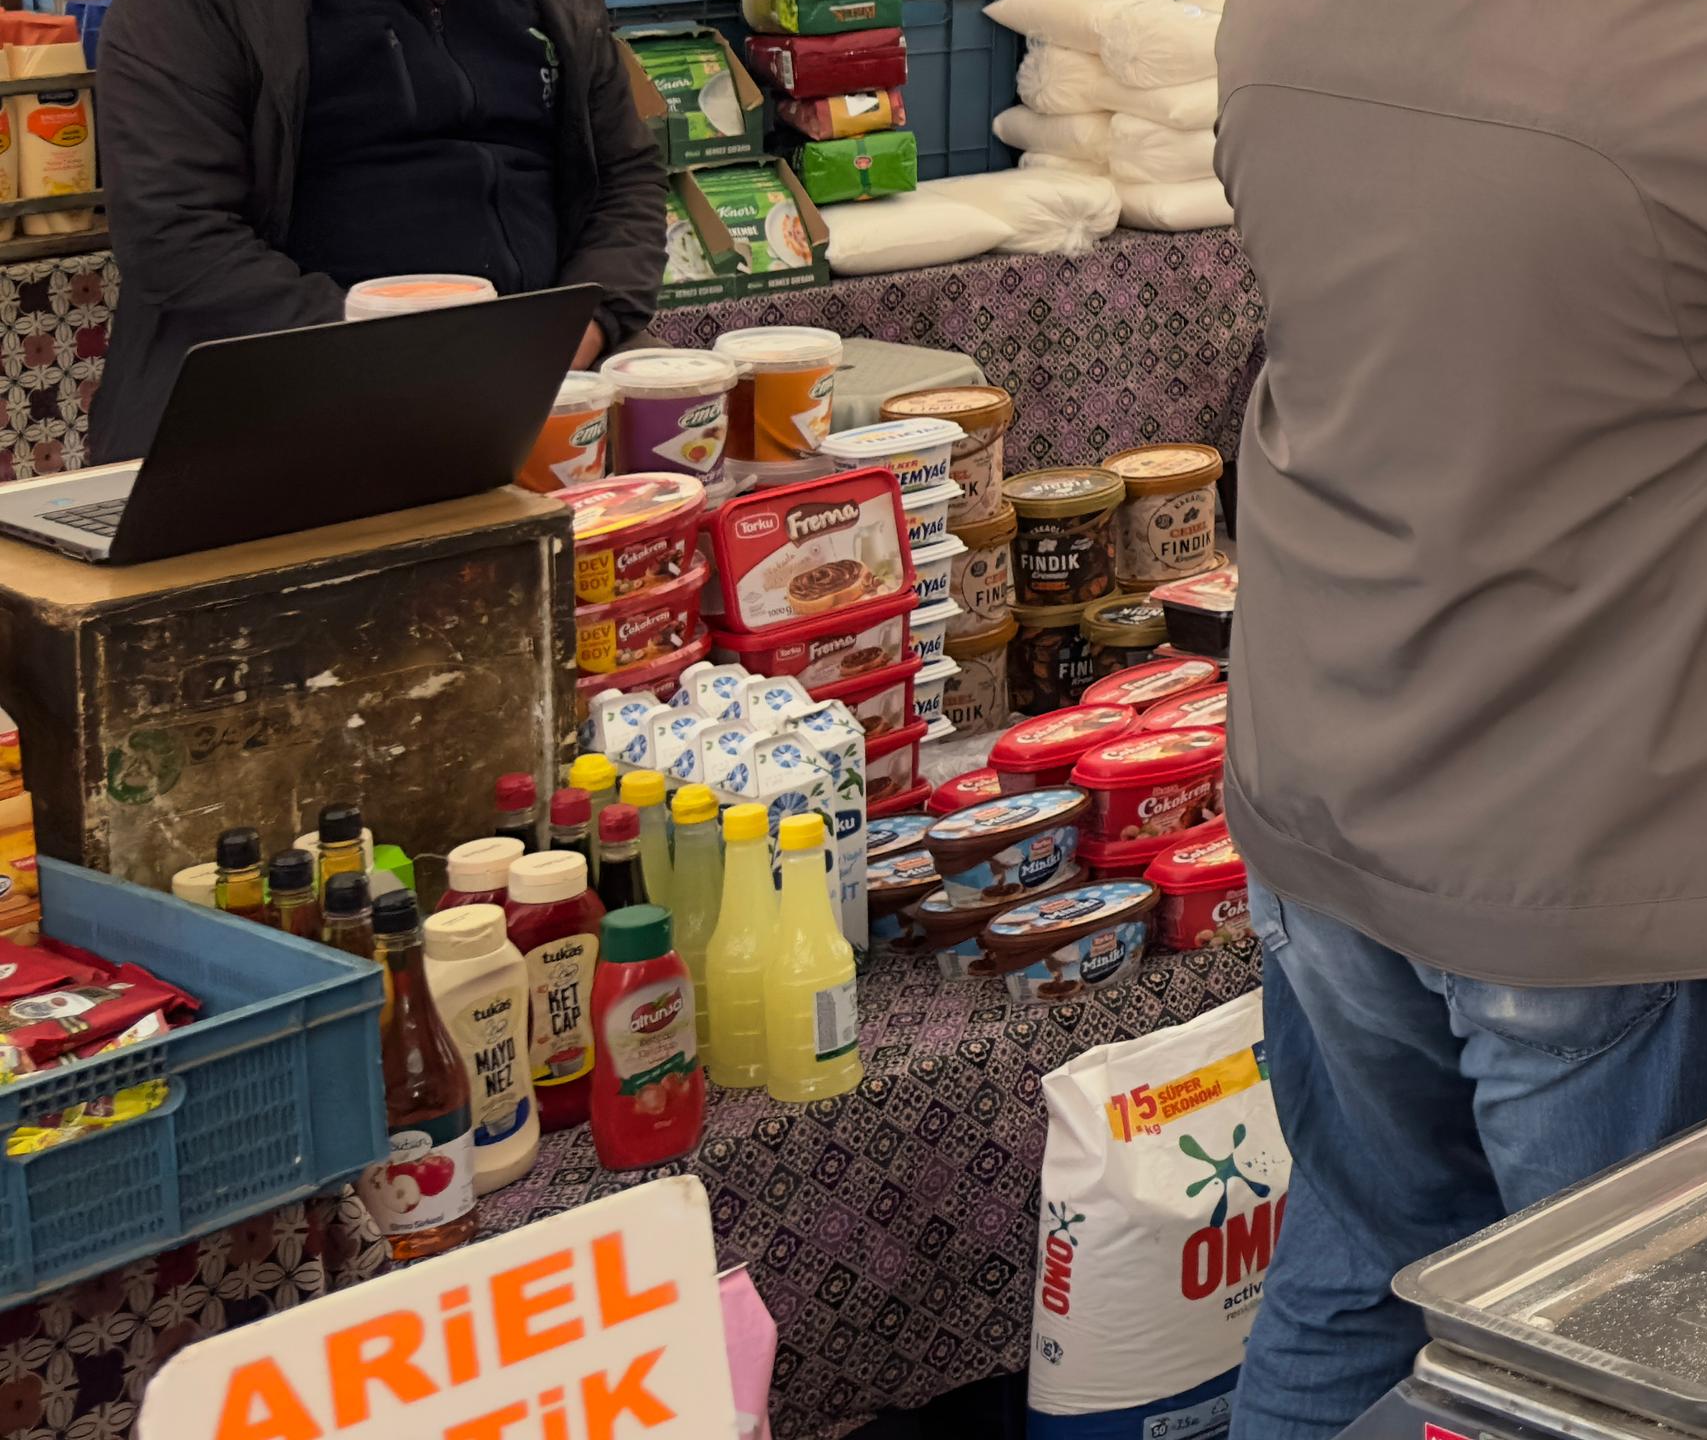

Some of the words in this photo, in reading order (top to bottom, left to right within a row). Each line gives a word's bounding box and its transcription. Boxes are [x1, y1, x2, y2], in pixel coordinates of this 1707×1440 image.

[718, 204, 758, 219] Knorr
[739, 517, 775, 534] Torku
[786, 504, 858, 539] Frema
[1161, 532, 1211, 558] FINDIK
[578, 555, 609, 574] DEV
[1021, 553, 1080, 571] FINDIK
[578, 576, 611, 593] BOY
[580, 625, 611, 642] DEV
[581, 643, 612, 661] BOY
[809, 634, 857, 661] Frema
[1021, 853, 1061, 877] Miniki
[1083, 948, 1124, 973] Miniki
[548, 981, 580, 1013] KET
[474, 1036, 516, 1076] MAYO
[485, 1068, 514, 1098] NEZ
[1157, 1076, 1201, 1104] SÜPER
[1041, 1233, 1075, 1317] OMO
[1222, 1281, 1265, 1310] activ
[215, 1230, 679, 1440] ARiEL
